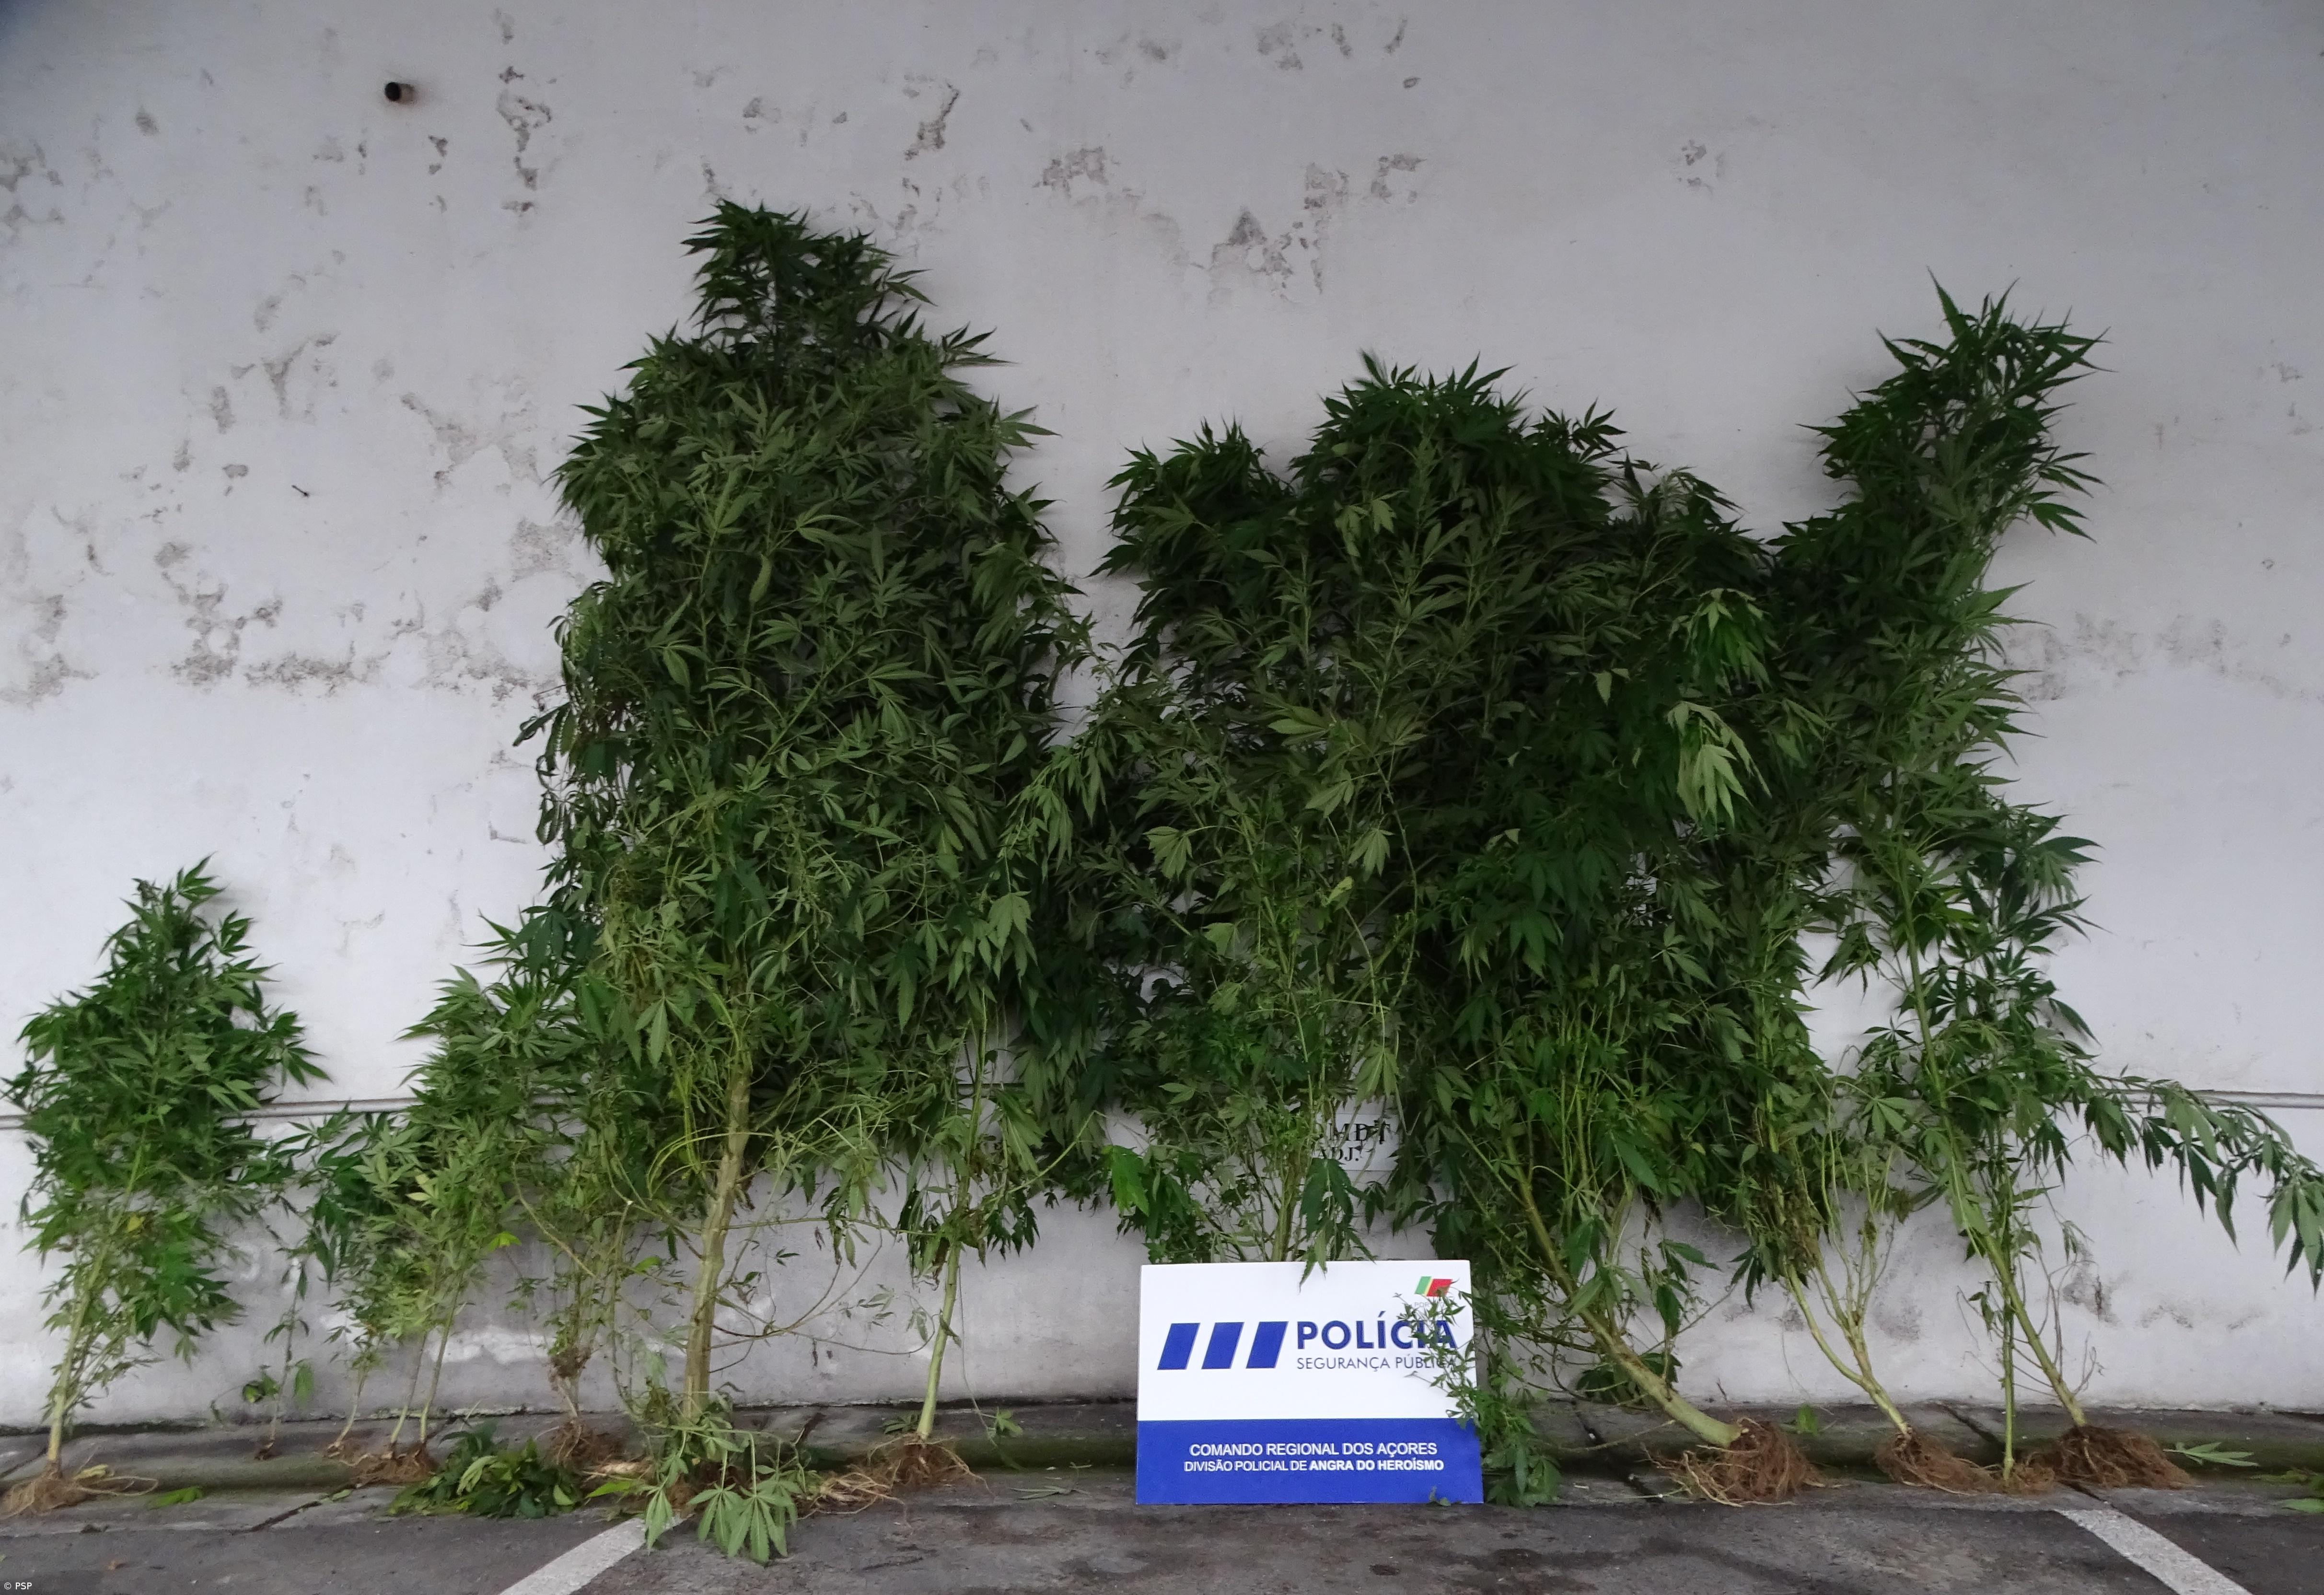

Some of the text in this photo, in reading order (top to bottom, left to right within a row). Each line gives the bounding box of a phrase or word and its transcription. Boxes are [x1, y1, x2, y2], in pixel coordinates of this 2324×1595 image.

[1297, 1310, 1458, 1350] POLÍCIA
[1297, 1353, 1456, 1372] SEGURANÇA PÚBLIA
[1189, 1442, 1438, 1458] COMANDO REGIONAL DOS AÇORES
[1184, 1457, 1444, 1472] DIVISÃO POLICIAL DE ANGRA DO HEROÍSMO
